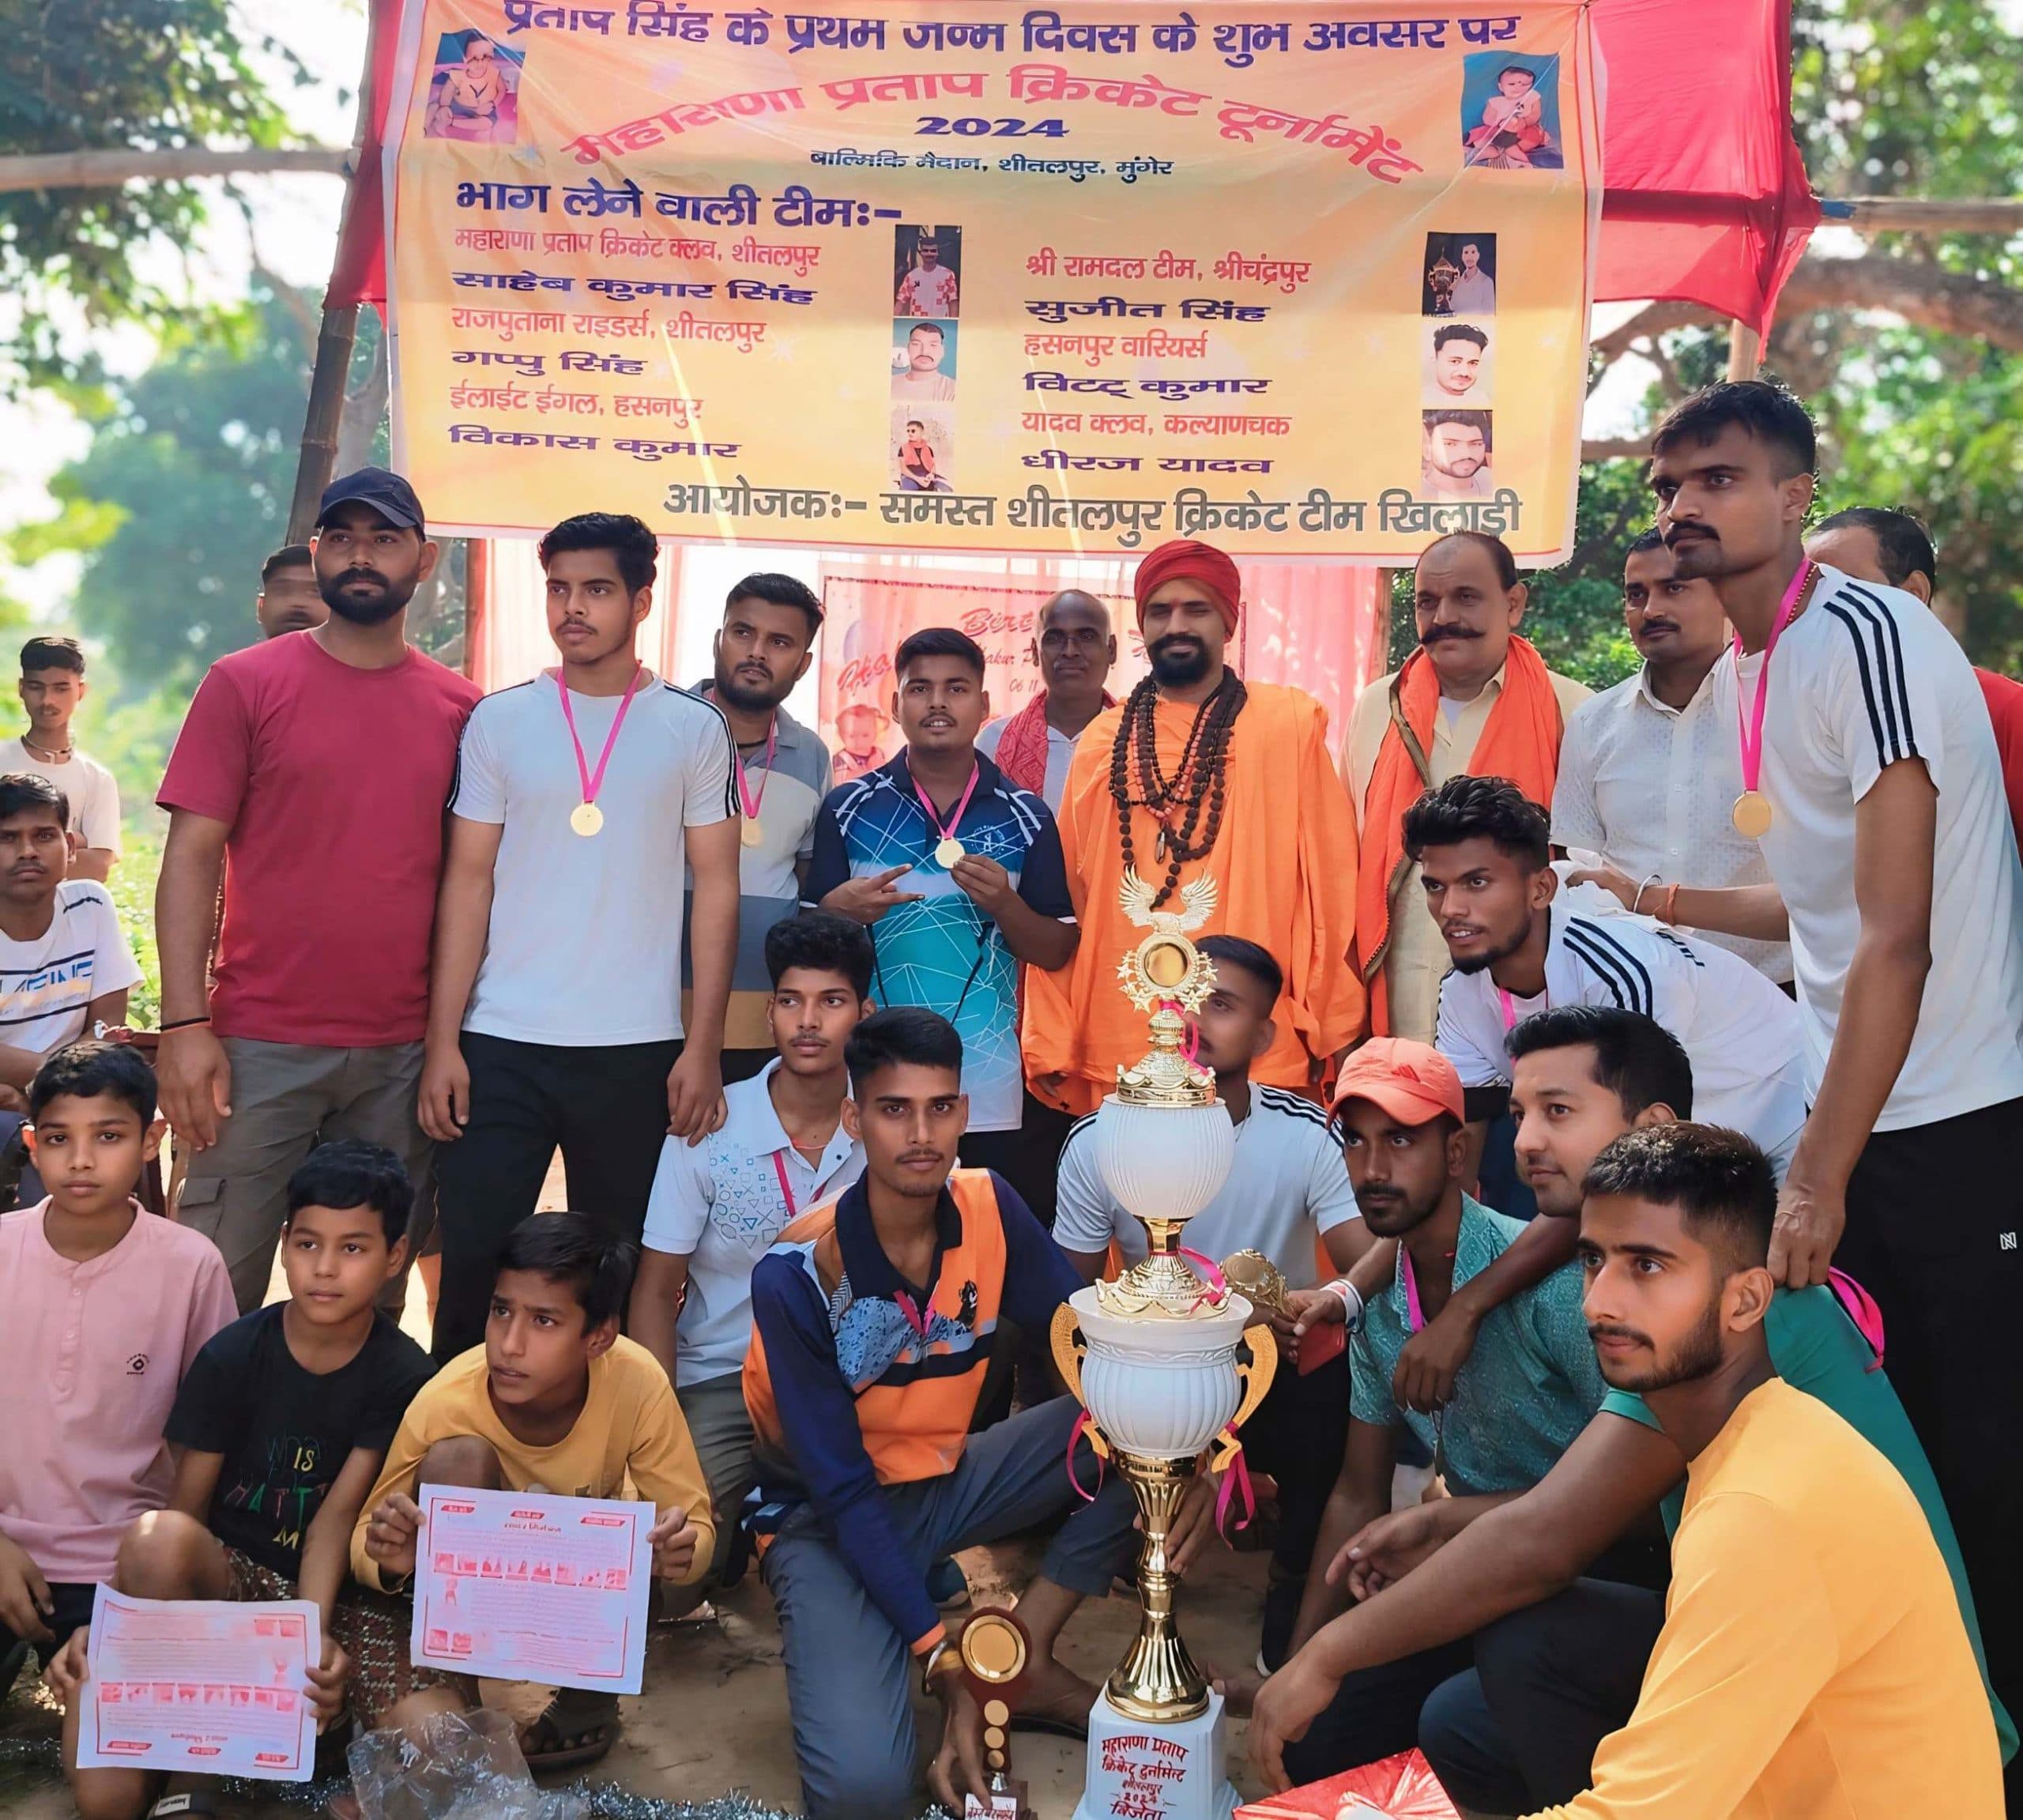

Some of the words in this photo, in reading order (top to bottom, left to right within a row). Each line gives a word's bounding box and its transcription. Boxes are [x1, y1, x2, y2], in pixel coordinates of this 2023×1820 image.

[504, 0, 615, 35] प्रताप
[627, 0, 713, 42] सिंह
[725, 8, 772, 46] के
[785, 14, 887, 53] प्रथम
[902, 21, 1008, 52] जन्म
[1021, 11, 1137, 52] दिवस
[1151, 13, 1200, 52] के
[1213, 21, 1290, 68] शुभ
[1303, 17, 1448, 51] अवसर
[1459, 16, 1520, 44] पर
[819, 73, 989, 111] प्रताप
[1006, 63, 1211, 117] क्रिकेट
[1218, 100, 1423, 184] टूर्नामेंट
[914, 116, 1070, 138] 2024
[915, 151, 988, 172] मैदान,
[998, 153, 1106, 183] शीतलपुर,
[1115, 155, 1175, 184] मुंगेर
[456, 180, 551, 213] भाग
[562, 177, 642, 218] लेने
[655, 183, 760, 226] वाली
[454, 228, 536, 252] महाराणा
[542, 232, 594, 256] प्रताप
[599, 228, 665, 260] क्रिकेट
[732, 235, 821, 277] शीतलपुर
[1026, 247, 1057, 277] श्री
[1063, 256, 1148, 279] रामदल
[1152, 249, 1203, 282] टीम,
[451, 269, 576, 292] साहेब
[586, 277, 717, 302] कुमार
[725, 279, 818, 305] सिंह
[1024, 296, 1166, 324] सुजीत
[1179, 298, 1271, 322] सिंह
[451, 307, 566, 341] राजपुताना
[665, 311, 767, 353] शीतलपुर
[558, 350, 648, 375] सिंह
[1023, 334, 1117, 367] हसनपुर
[1139, 379, 1272, 401] कुमार
[613, 395, 704, 429] हसनपुर
[1021, 413, 1083, 432] यादव
[1163, 415, 1292, 435] कल्याणचक
[449, 424, 601, 450] विकास
[612, 438, 742, 462] कुमार
[1021, 449, 1144, 472] धीरज
[1157, 458, 1275, 474] यादव
[880, 492, 997, 527] समस्त
[1008, 484, 1166, 548] शीतलपुर
[1173, 486, 1292, 536] क्रिकेट
[1298, 486, 1367, 533] टीम
